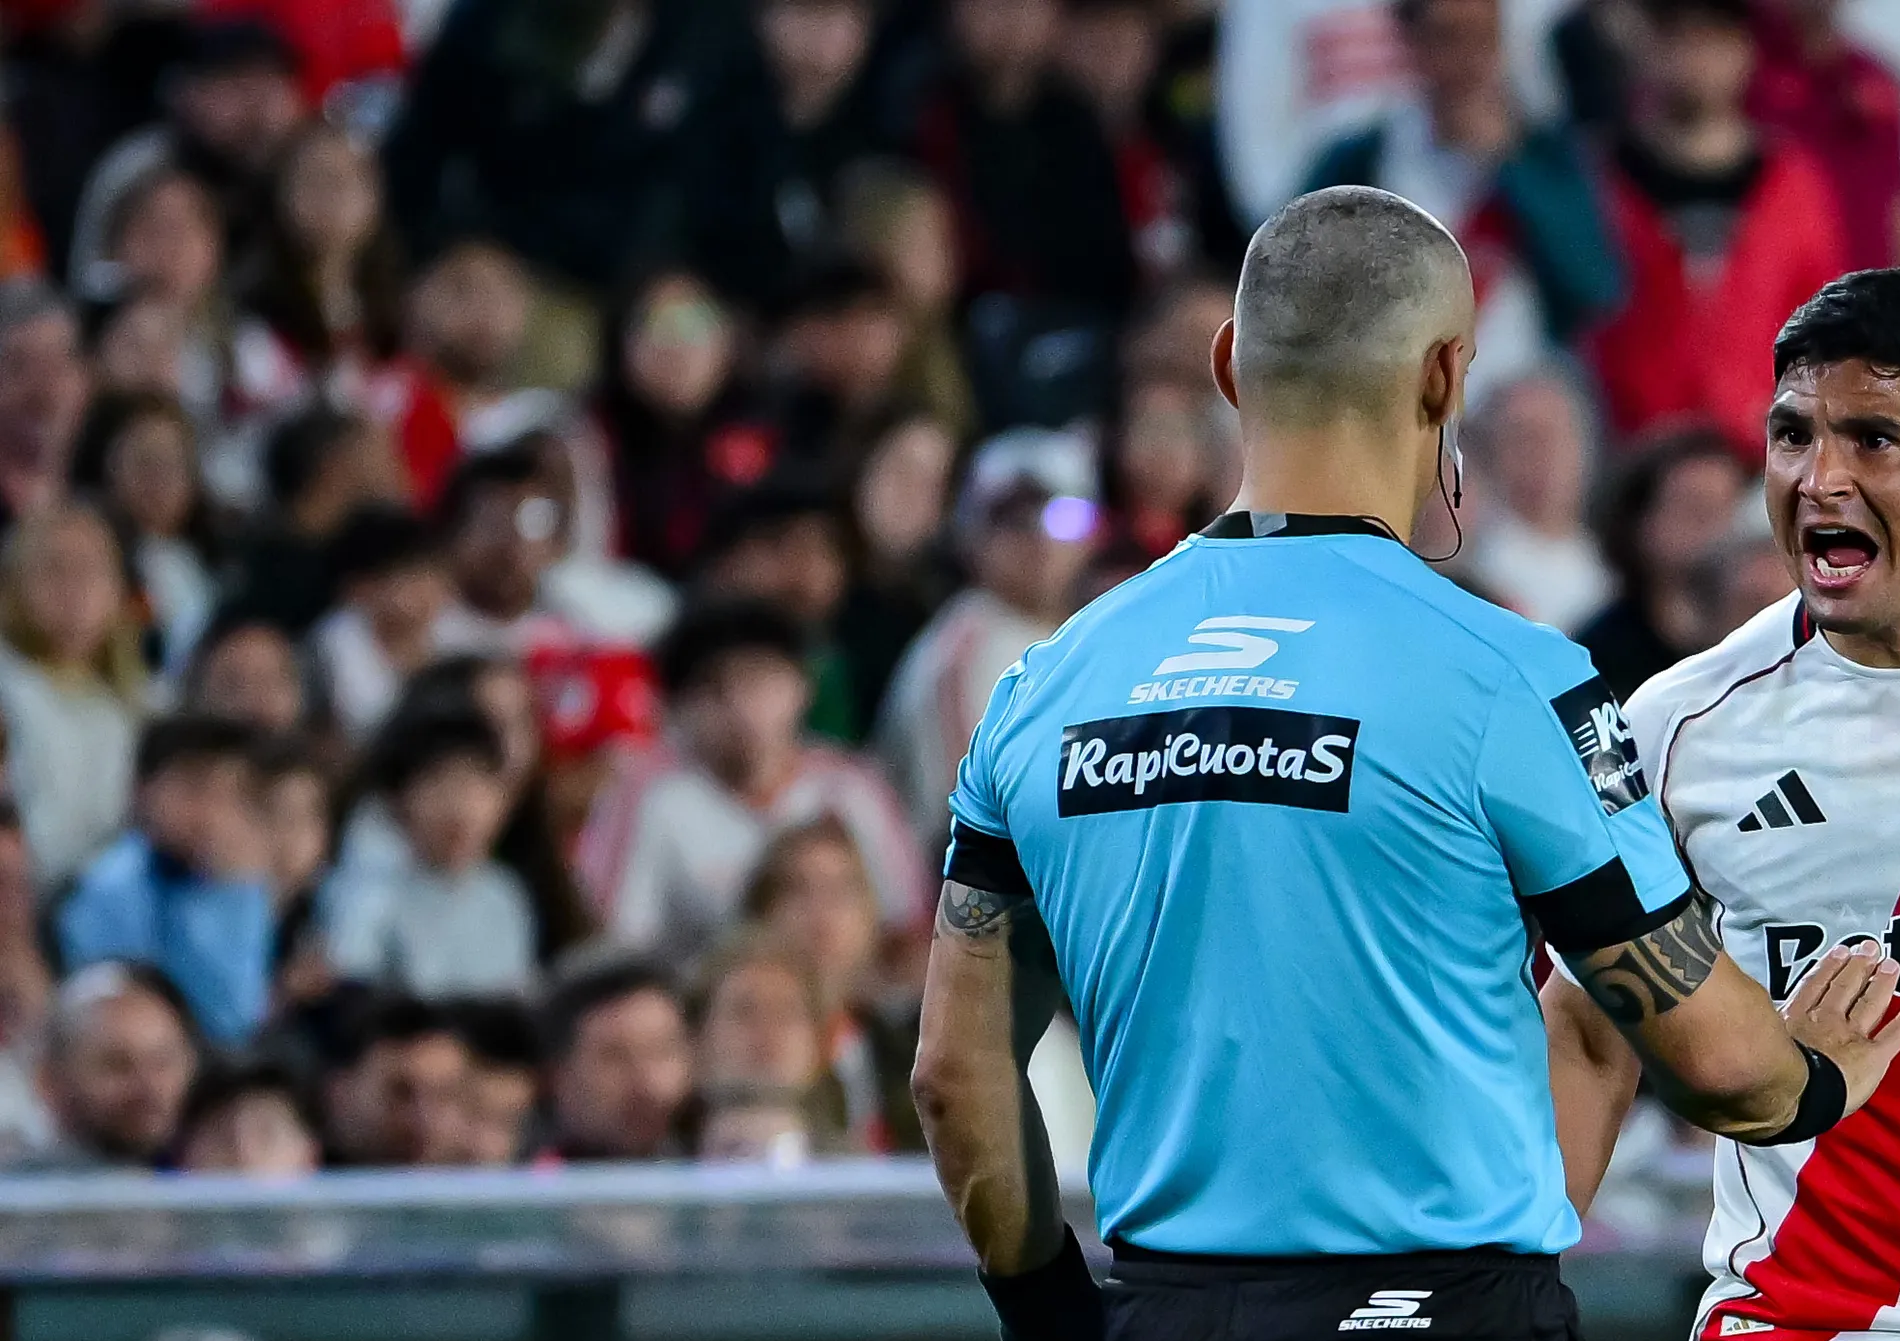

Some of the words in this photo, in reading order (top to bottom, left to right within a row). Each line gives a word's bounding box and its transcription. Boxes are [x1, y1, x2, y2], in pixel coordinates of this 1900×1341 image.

[1127, 675, 1300, 704] SKECHERS
[1062, 733, 1352, 795] RapiCuotaS
[1338, 1317, 1432, 1331] SKECHERS
